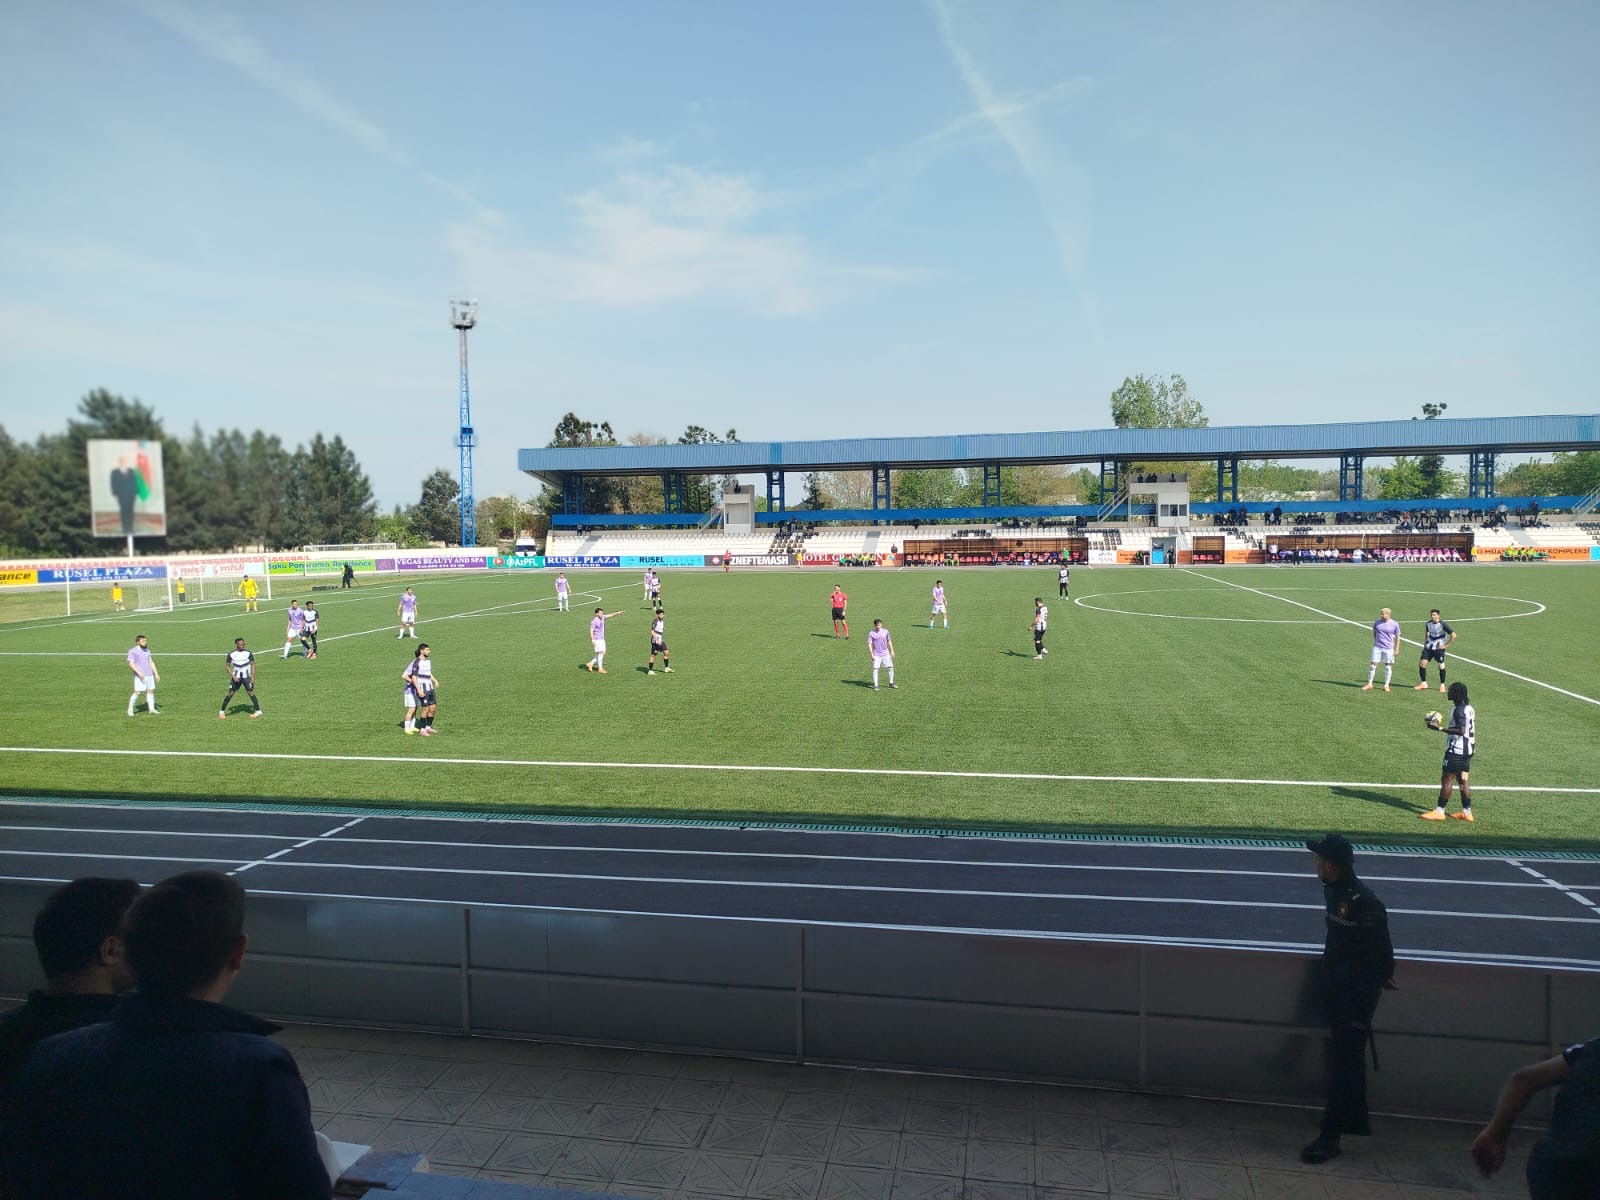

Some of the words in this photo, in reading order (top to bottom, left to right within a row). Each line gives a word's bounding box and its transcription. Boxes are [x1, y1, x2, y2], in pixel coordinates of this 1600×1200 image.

[547, 556, 582, 564] RUSEL
[583, 556, 618, 564] PLAZA
[730, 556, 789, 565] ZNEFTEMASH
[53, 568, 102, 579] RUSEL
[105, 566, 153, 577] PLAZA
